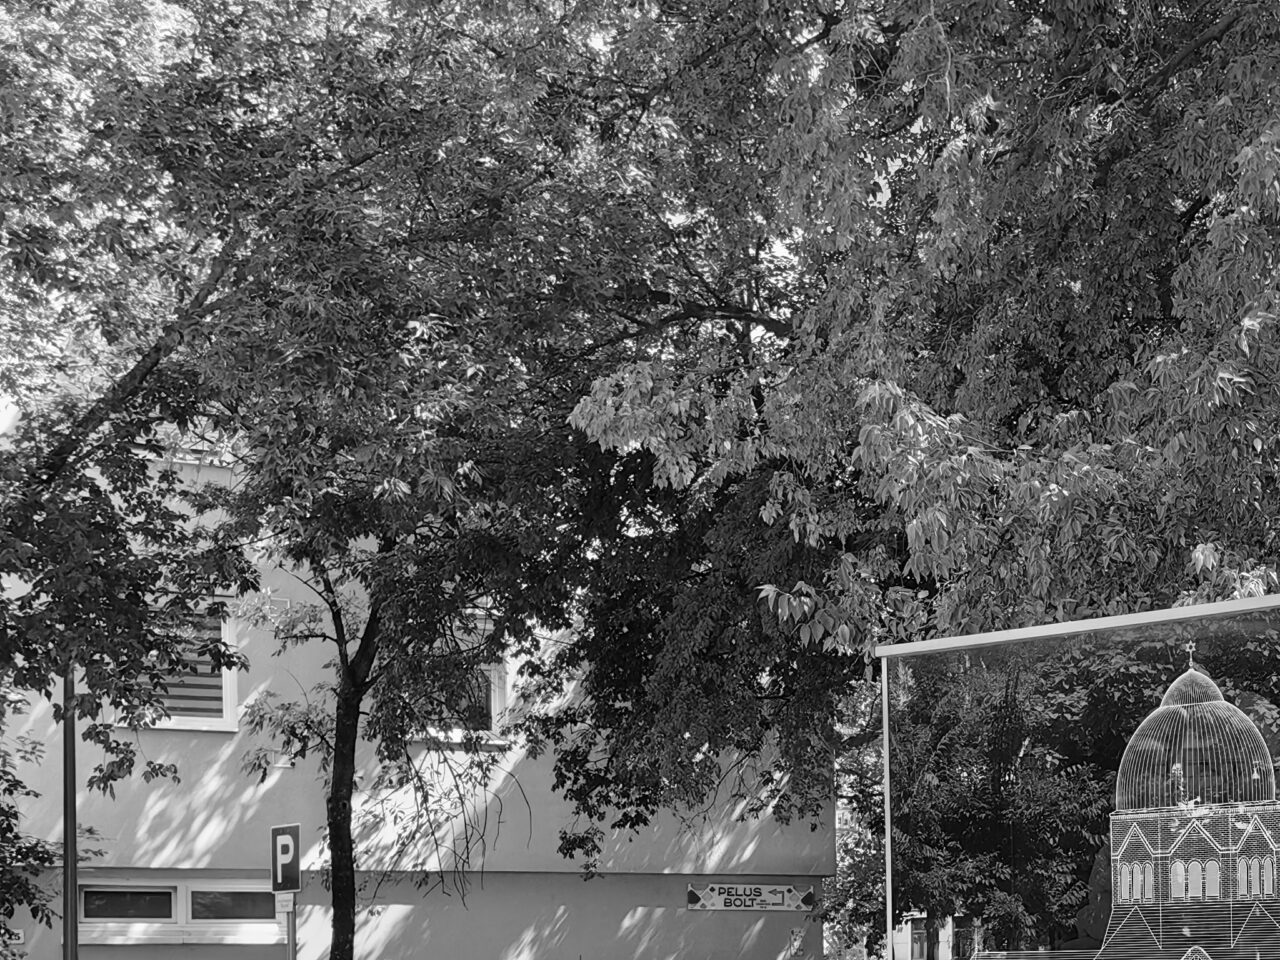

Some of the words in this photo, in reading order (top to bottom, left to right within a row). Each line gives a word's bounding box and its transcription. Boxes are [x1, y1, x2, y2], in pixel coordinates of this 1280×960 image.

[276, 834, 294, 883] P
[718, 887, 762, 897] PELUS
[724, 898, 756, 907] BOLT
